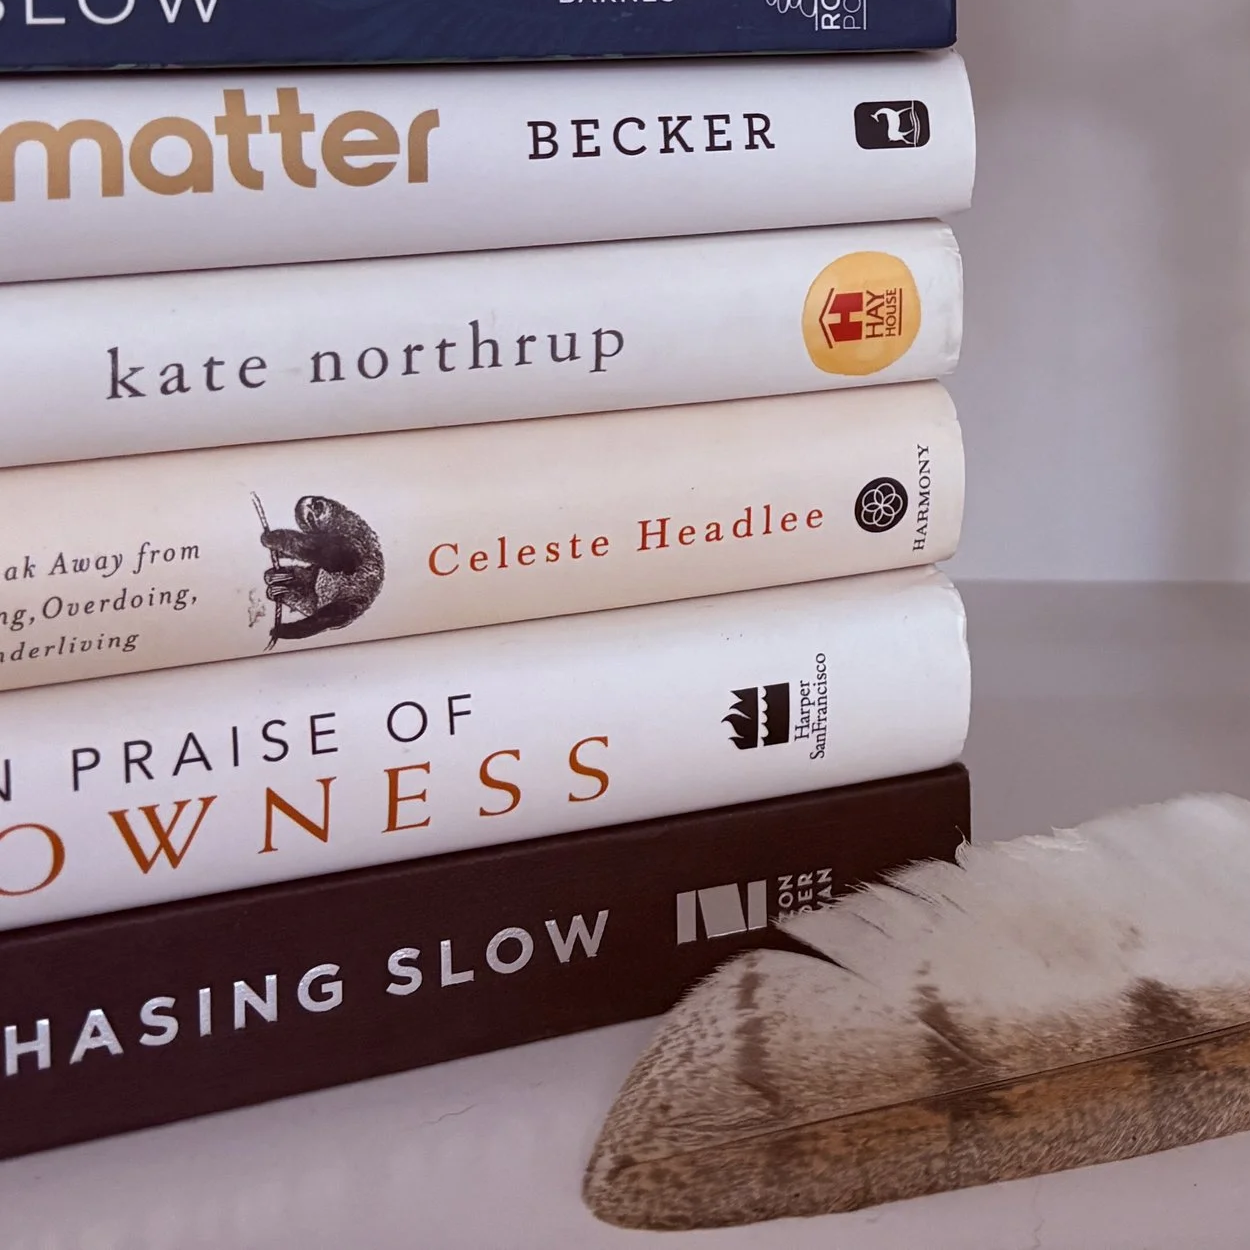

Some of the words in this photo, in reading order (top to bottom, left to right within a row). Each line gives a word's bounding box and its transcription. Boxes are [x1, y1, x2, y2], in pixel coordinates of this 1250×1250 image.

[0, 87, 440, 202] matter
[527, 112, 775, 160] BECKER
[865, 290, 885, 339] HAY
[885, 288, 897, 337] HOUSE
[106, 346, 268, 400] kate
[310, 319, 625, 385] northrup
[912, 444, 930, 551] HARMONY
[48, 552, 123, 577] Away
[133, 541, 200, 575] from
[428, 534, 610, 576] Celeste
[638, 505, 824, 551] Headlee
[42, 587, 197, 619] Overdoing,
[71, 712, 339, 791] PRAISE
[386, 694, 472, 743] OF
[794, 680, 815, 742] Harper
[809, 653, 827, 761] SanFrancisco
[386, 910, 609, 996] SLOW
